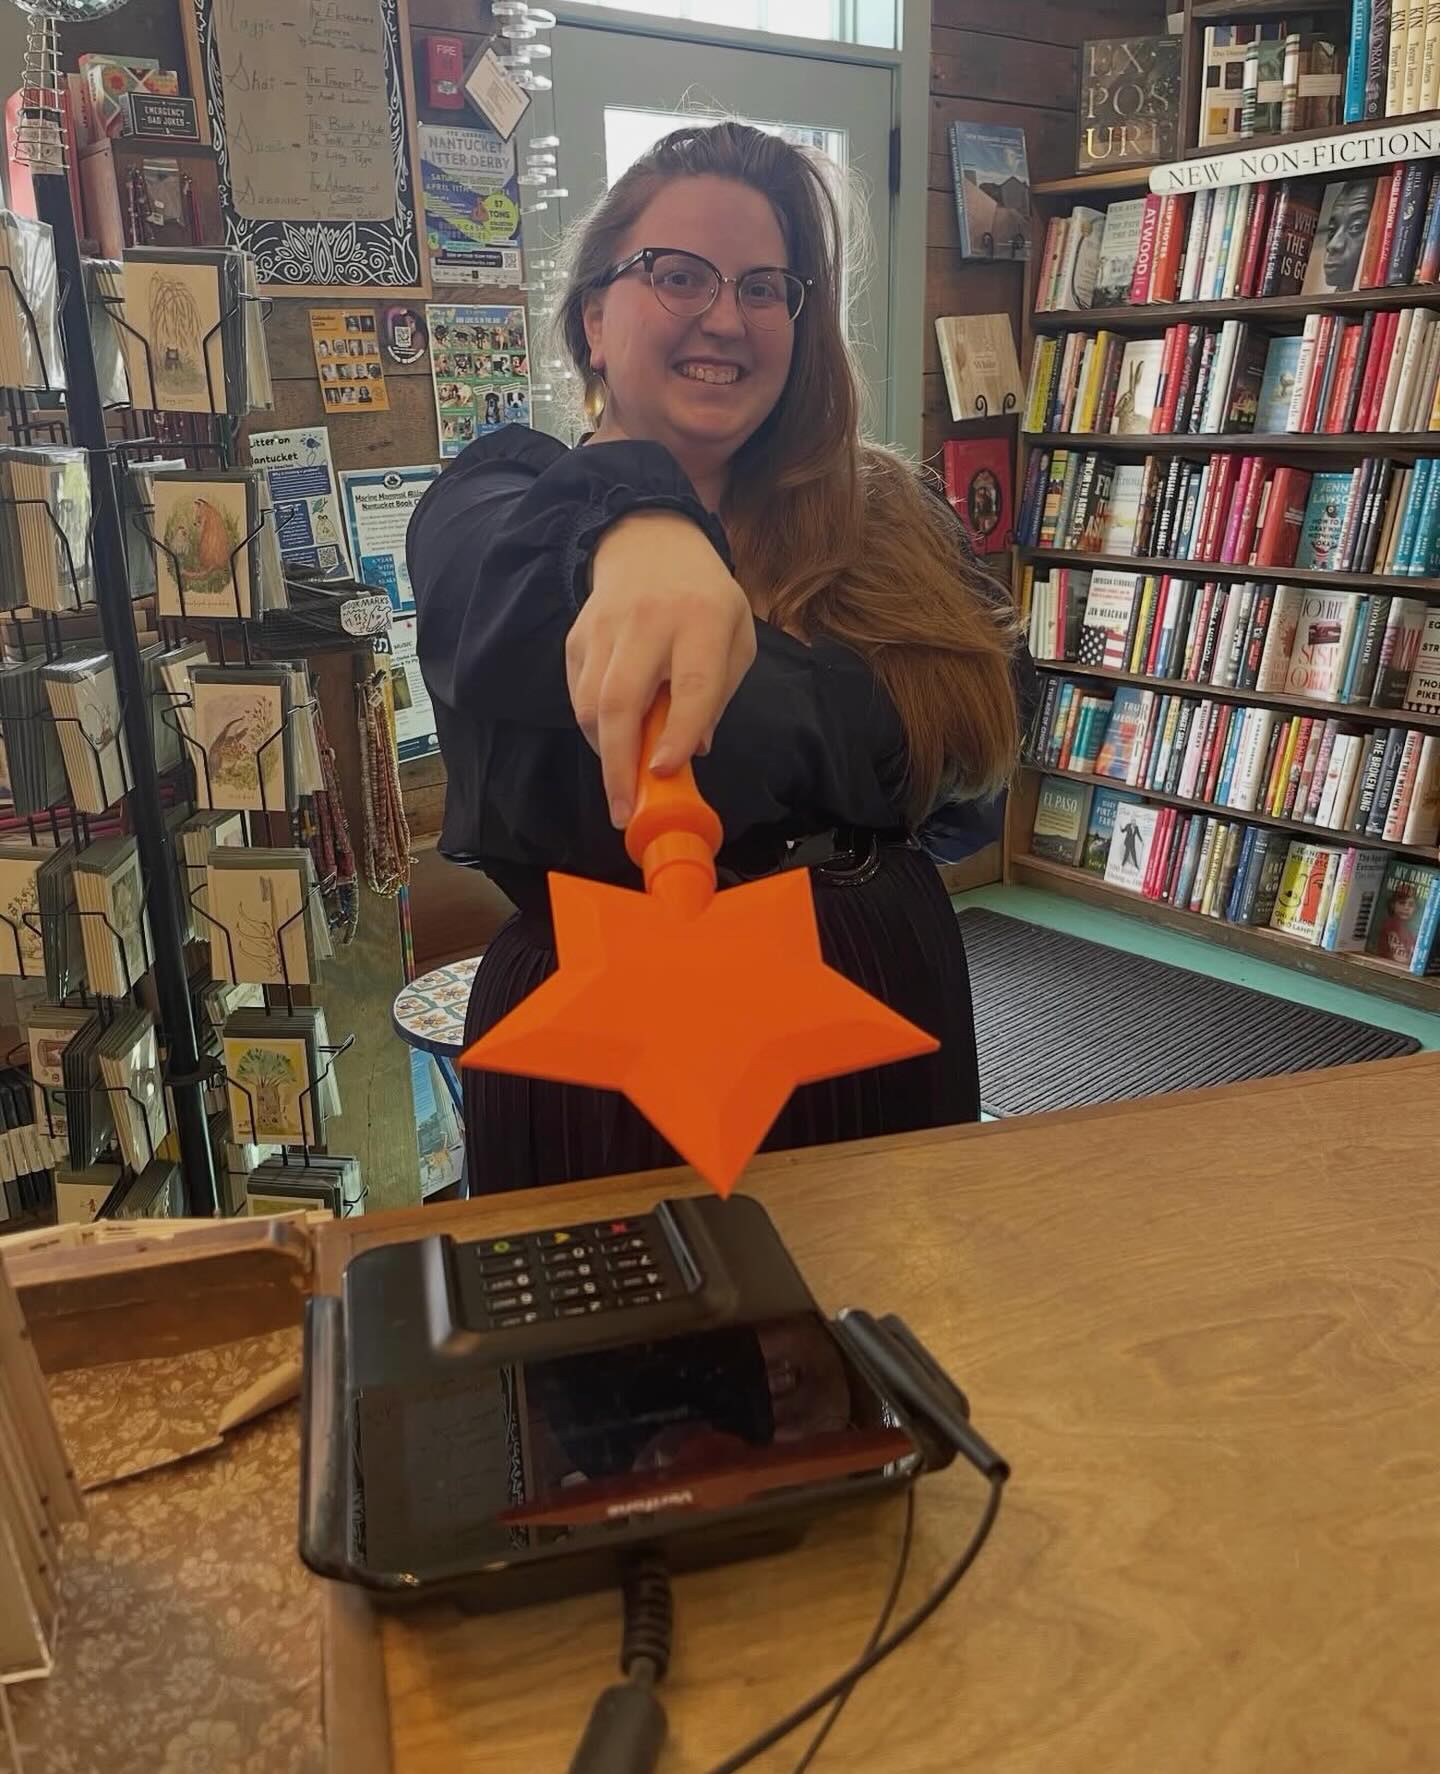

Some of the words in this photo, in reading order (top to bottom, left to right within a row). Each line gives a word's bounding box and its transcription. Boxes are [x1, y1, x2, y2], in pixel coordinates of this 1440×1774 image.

[1391, 10, 1405, 32] KIN
[1409, 7, 1424, 28] KIN
[436, 44, 456, 56] FIRE
[145, 106, 184, 116] EMERGENCY
[163, 117, 184, 126] JOKES
[429, 136, 502, 153] NANTUCKET
[470, 155, 509, 168] DERBY
[1168, 161, 1224, 190] NEW
[1240, 128, 1433, 179] NON-FICTION
[1161, 195, 1175, 259] CRIPTNOTES
[1295, 211, 1317, 233] WHE
[1137, 208, 1156, 275] ATWOOD
[1286, 232, 1306, 256] THE
[1281, 257, 1293, 275] IS
[1293, 261, 1307, 279] GO
[1083, 457, 1096, 482] FROM
[1321, 482, 1348, 492] JENN
[362, 501, 395, 511] Nantucket
[396, 499, 413, 508] Book
[1312, 494, 1349, 505] LAWSO
[1075, 498, 1088, 526] ASHES
[1370, 599, 1381, 634] THOMAS
[1375, 739, 1386, 755] THE
[1366, 756, 1384, 789] BROKEN
[1054, 795, 1078, 814] PASO
[1360, 790, 1374, 812] KING
